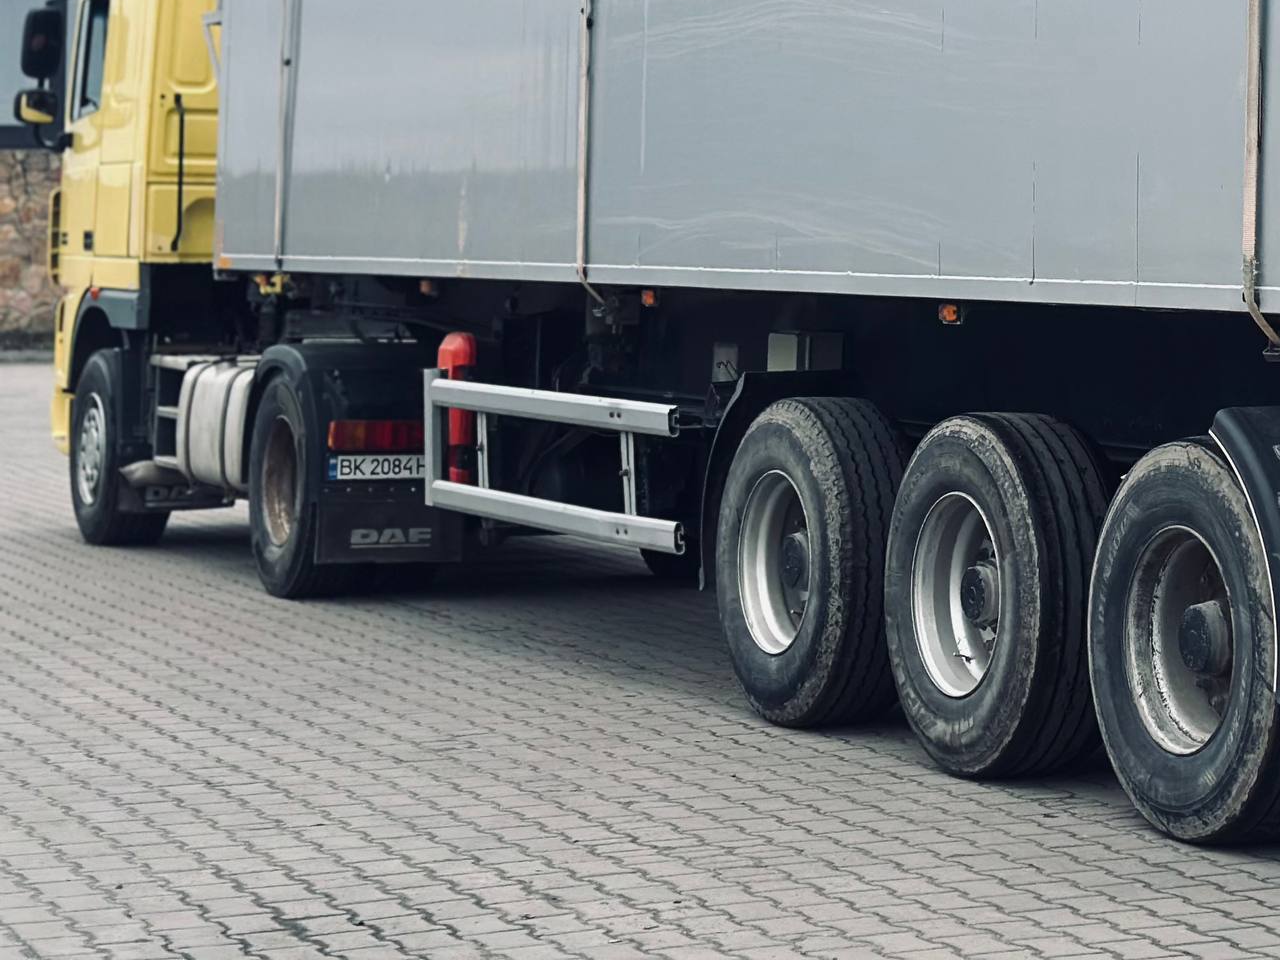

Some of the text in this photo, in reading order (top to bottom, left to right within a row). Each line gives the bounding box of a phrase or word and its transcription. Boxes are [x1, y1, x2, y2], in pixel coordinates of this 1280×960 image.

[340, 458, 366, 476] BK
[370, 457, 413, 476] 2084
[350, 528, 432, 544] DAF
